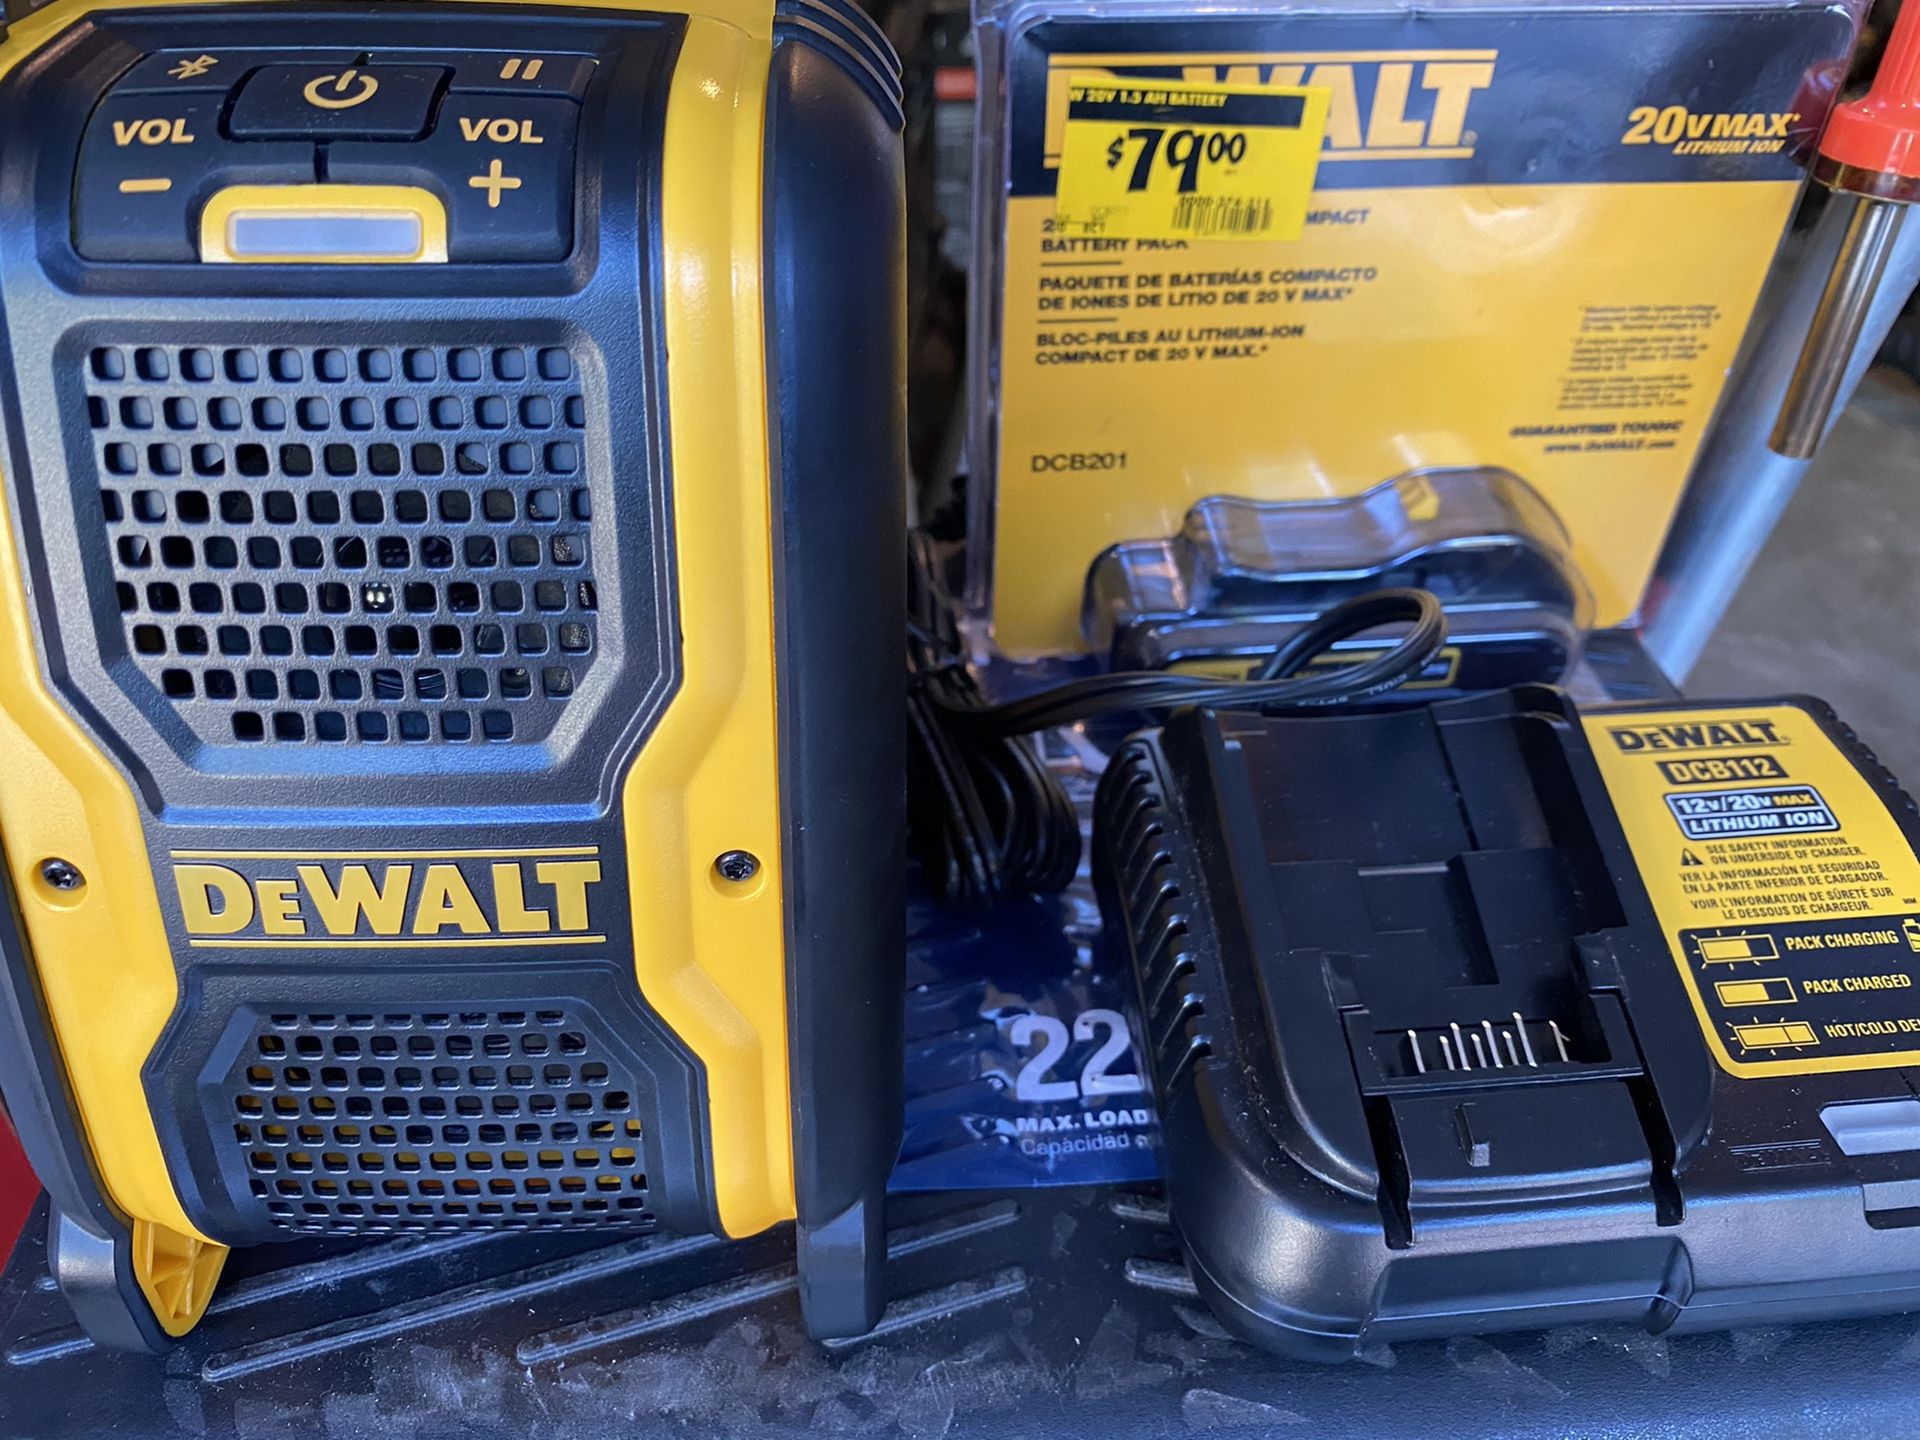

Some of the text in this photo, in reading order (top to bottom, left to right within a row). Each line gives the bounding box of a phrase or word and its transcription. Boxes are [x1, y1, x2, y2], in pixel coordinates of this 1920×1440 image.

[1087, 88, 1117, 103] 20V
[1144, 91, 1168, 105] AH
[1169, 92, 1227, 107] BATTERY
[112, 118, 195, 146] VOL
[459, 118, 544, 144] VOL
[1672, 140, 1786, 155] LITHIUM ION
[1042, 238, 1129, 253] BATTERY
[1040, 267, 1377, 291] PAQUETE DE BATERÍAS COMPACTO
[1039, 297, 1065, 312] DE
[1071, 294, 1129, 310] IONES
[1137, 293, 1162, 308] DE
[1168, 291, 1218, 307] LITIO
[1224, 290, 1250, 305] DE
[1256, 290, 1279, 305] 20
[1285, 289, 1298, 303] V
[1037, 324, 1305, 347] BLOC-PILES AU LITHIUM-ION
[1036, 349, 1128, 366] COMPACT
[1135, 347, 1160, 363] DE
[1167, 346, 1189, 361] 20
[1196, 345, 1209, 359] V
[1031, 453, 1128, 472] DCB201
[1667, 757, 1778, 783] DCB112
[1772, 793, 1816, 806] MAX
[1689, 811, 1827, 834] LITHIUM ION
[1706, 837, 1848, 855] SEE SAFETY INFORMATION
[1711, 847, 1866, 865] ON UNDERSIDE OF CHARGER.
[1680, 861, 1881, 884] VER LA INFORMACIÓN DE SEGURIDAD
[1683, 871, 1889, 894] EN LA PARTE INFERIOR DE CARGADOR.
[173, 860, 601, 935] DEWALT
[1691, 899, 1719, 910] VOIR
[1721, 893, 1808, 908] L'INFORMATION
[1810, 891, 1826, 902] DE
[1871, 887, 1894, 898] SUR
[1722, 901, 1873, 920] LE DESSOUS DE CHARGEUR.
[1784, 930, 1900, 951] PACK CHARGING
[1802, 974, 1912, 994] PACK CHARGED
[1824, 1021, 1898, 1038] HOT/COLD
[1011, 1008, 1144, 1101] 22
[1016, 1109, 1149, 1132] MAX. LOAD
[1020, 1132, 1130, 1156] Capacidad
